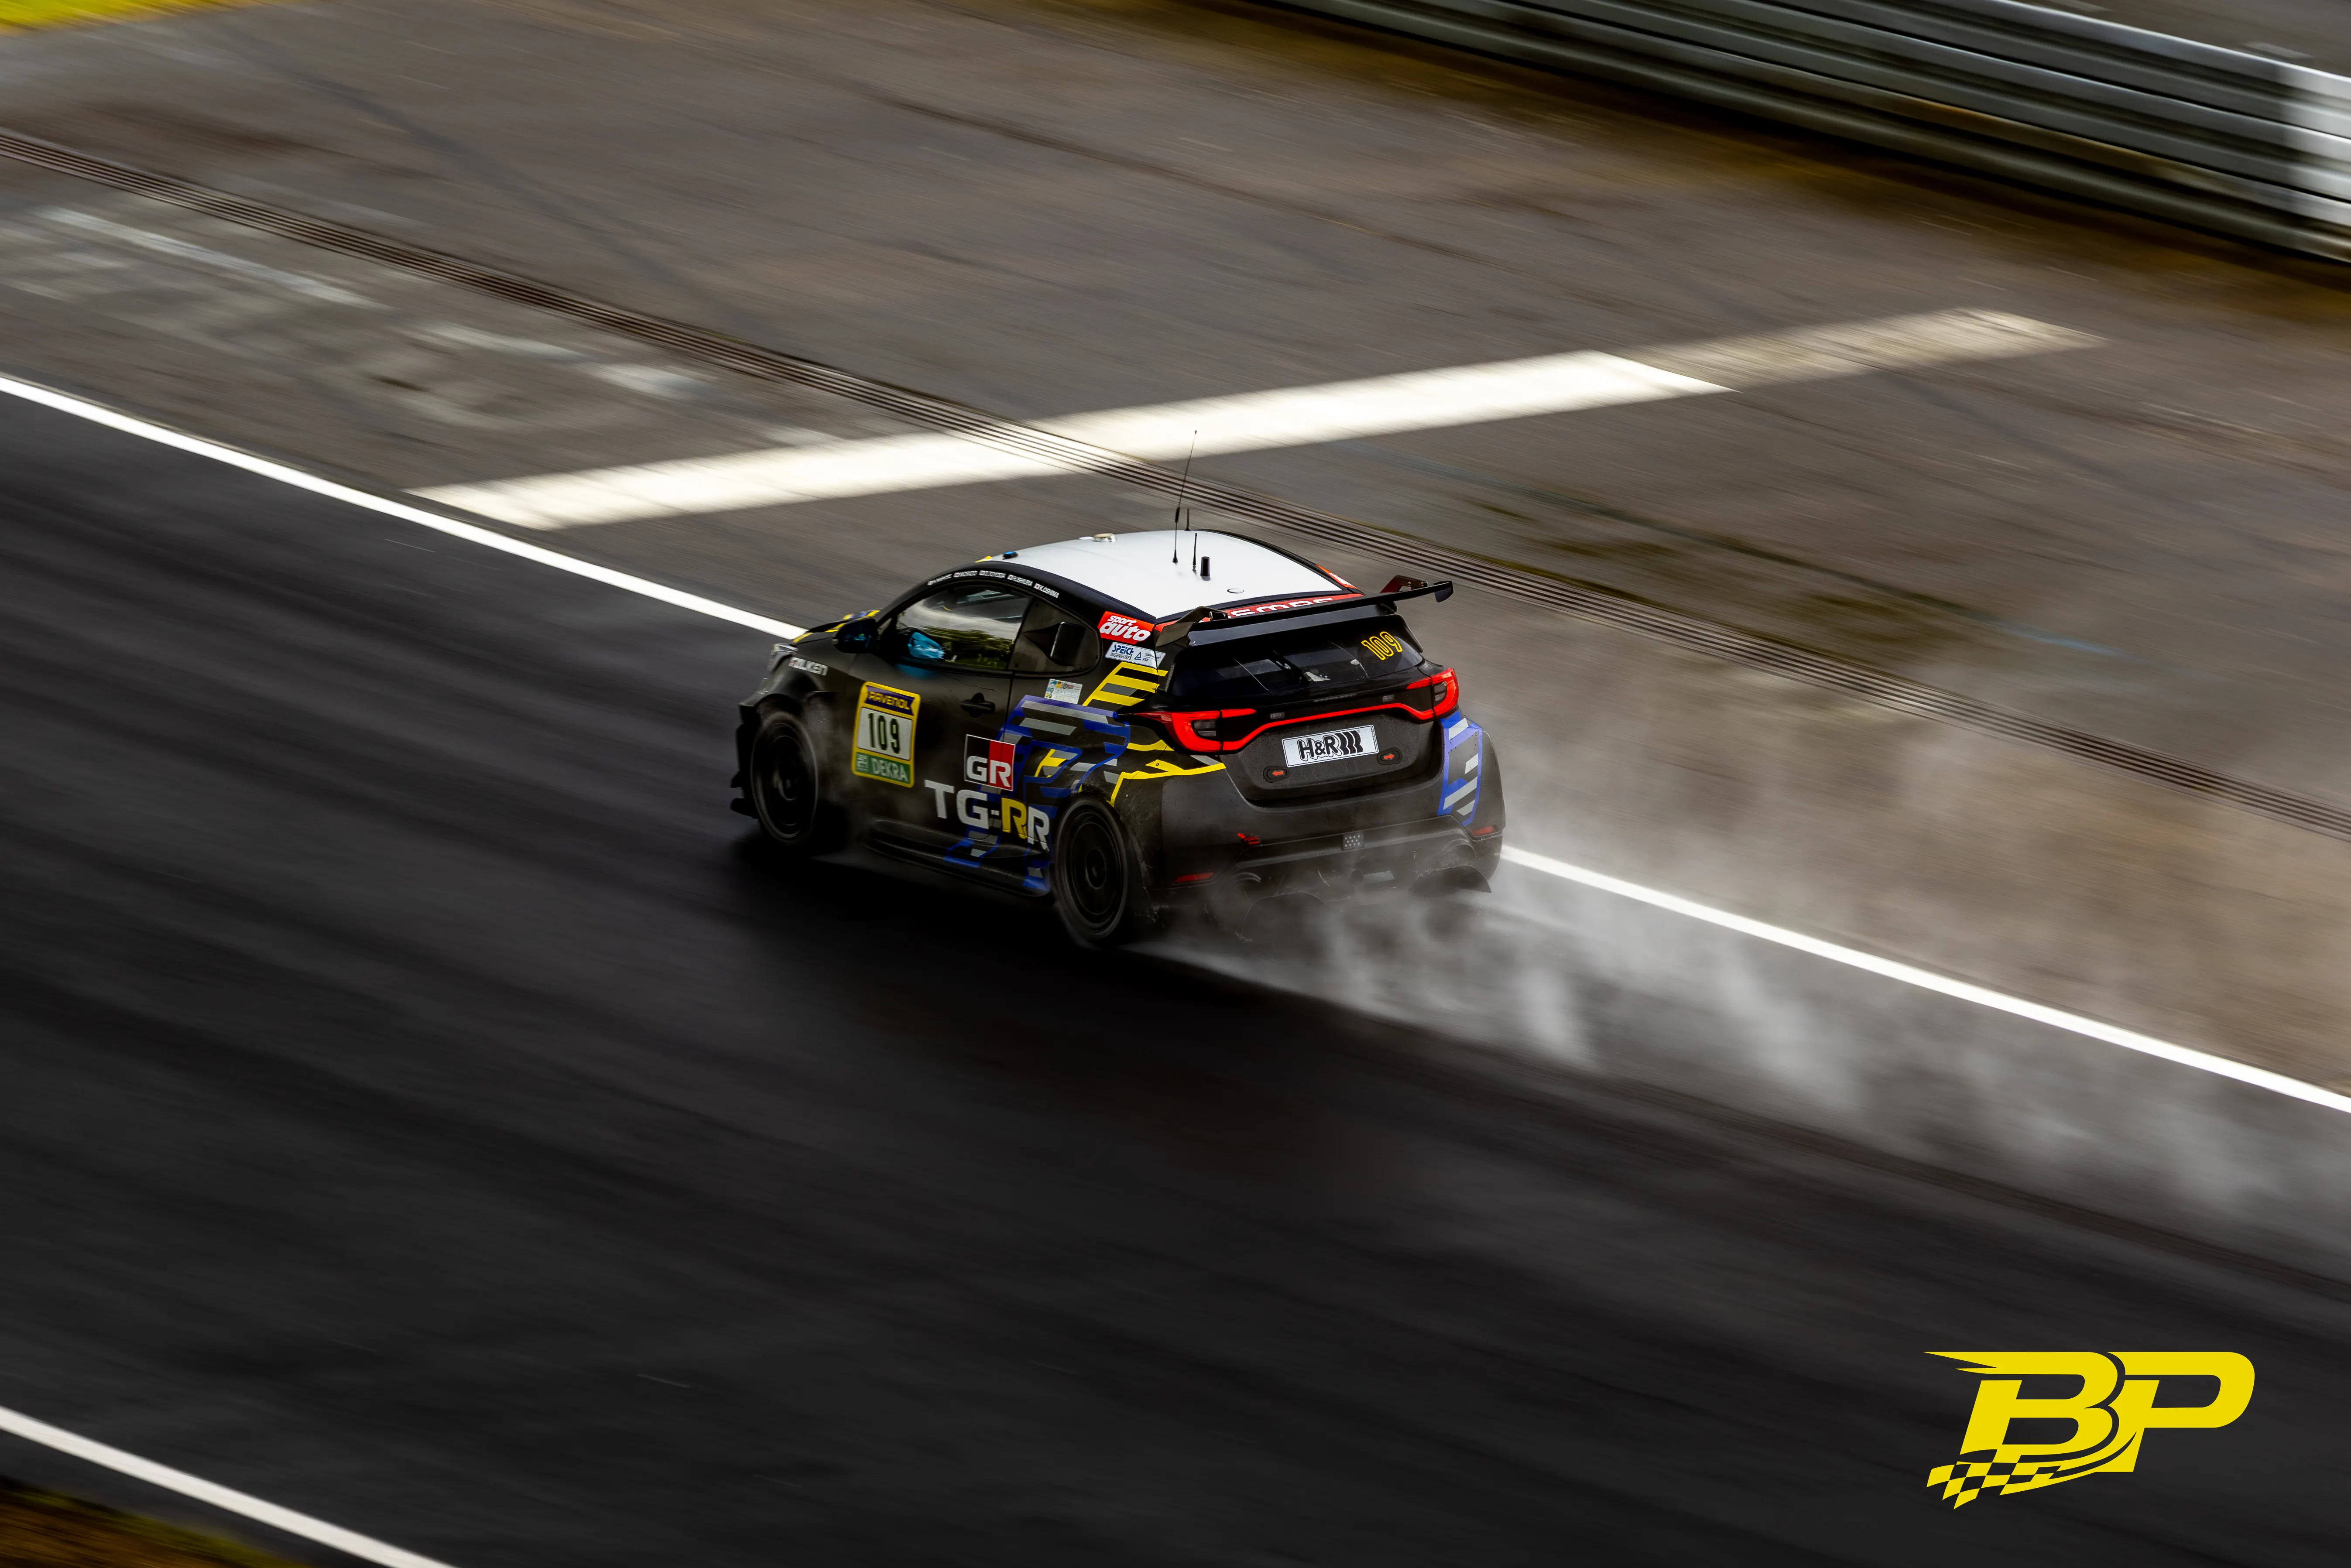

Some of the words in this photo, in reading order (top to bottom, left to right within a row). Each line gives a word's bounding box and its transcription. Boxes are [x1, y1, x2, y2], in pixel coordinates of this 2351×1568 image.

[1100, 622, 1151, 642] auto
[1107, 615, 1137, 626] sport
[1361, 631, 1403, 660] 109
[868, 691, 910, 710] RAVENOL
[868, 712, 900, 754] 109
[1298, 735, 1342, 761] H&R
[871, 758, 908, 782] DEKRA
[966, 756, 1011, 787] GR
